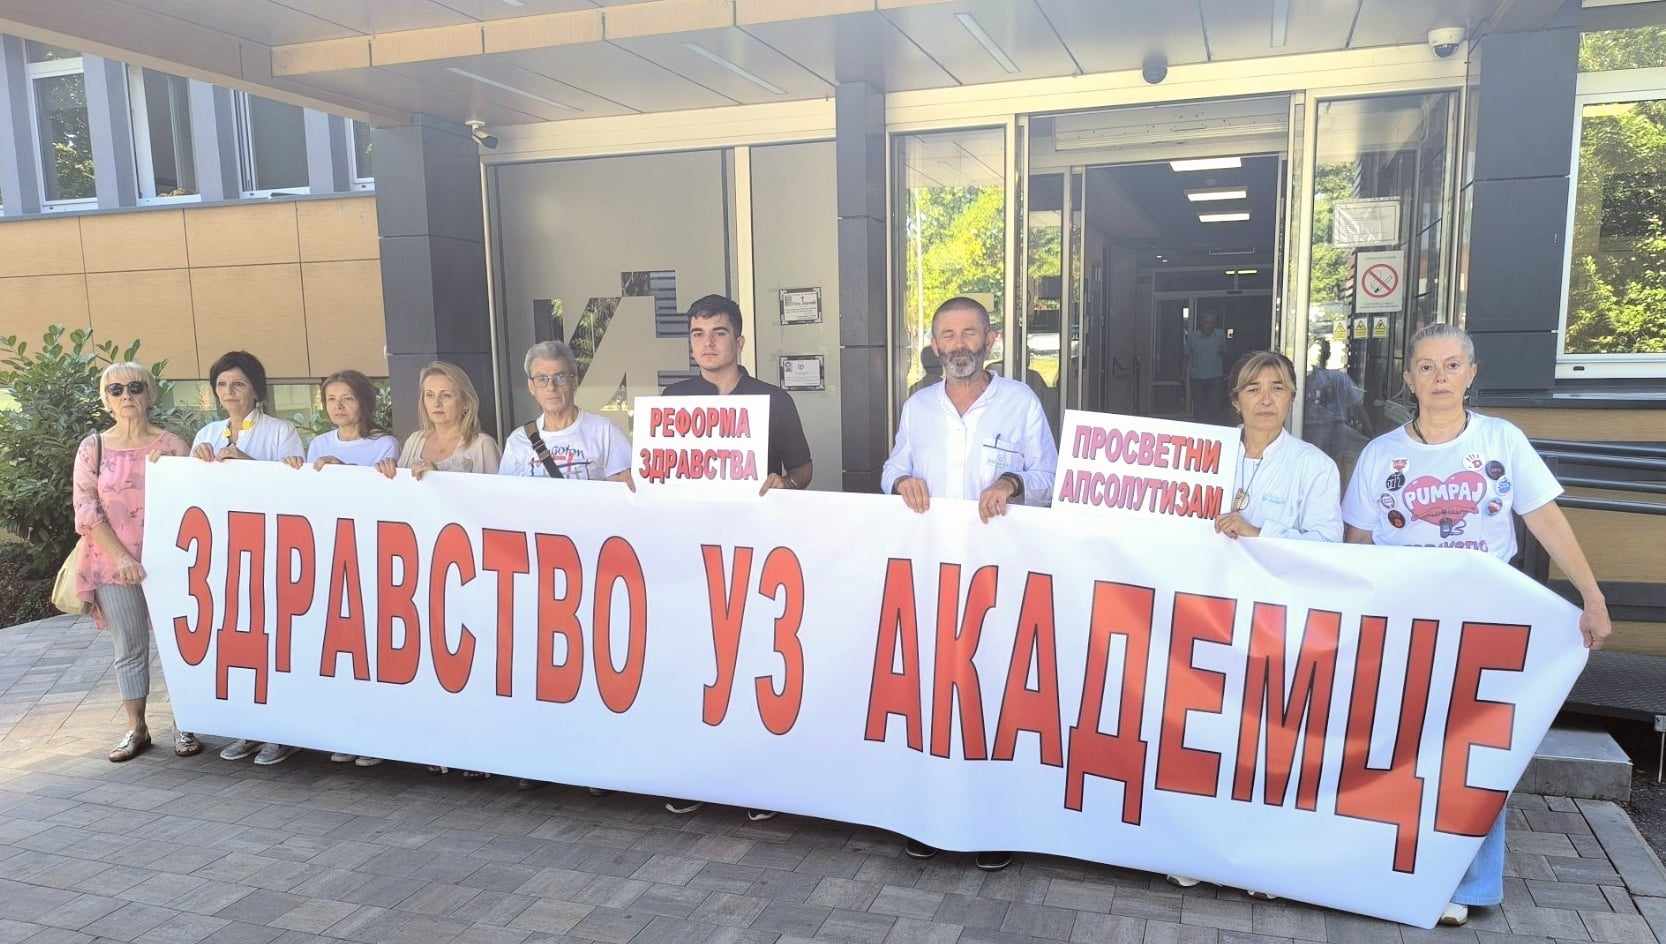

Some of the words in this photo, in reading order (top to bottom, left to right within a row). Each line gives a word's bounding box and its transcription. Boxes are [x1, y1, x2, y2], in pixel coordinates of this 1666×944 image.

[650, 407, 751, 438] РЕФОРМА
[639, 447, 758, 484] ЗДРАВСТВА
[1072, 424, 1222, 474] ПРОСВЕТНИ
[1059, 468, 1224, 520] АПСОЛУТИЗАМ
[1405, 482, 1484, 510] PUMPAJ
[172, 505, 648, 714] ЗДРАВСТВО
[699, 543, 806, 737] УЗ
[863, 557, 1532, 875] АКАДЕМЦЕ
